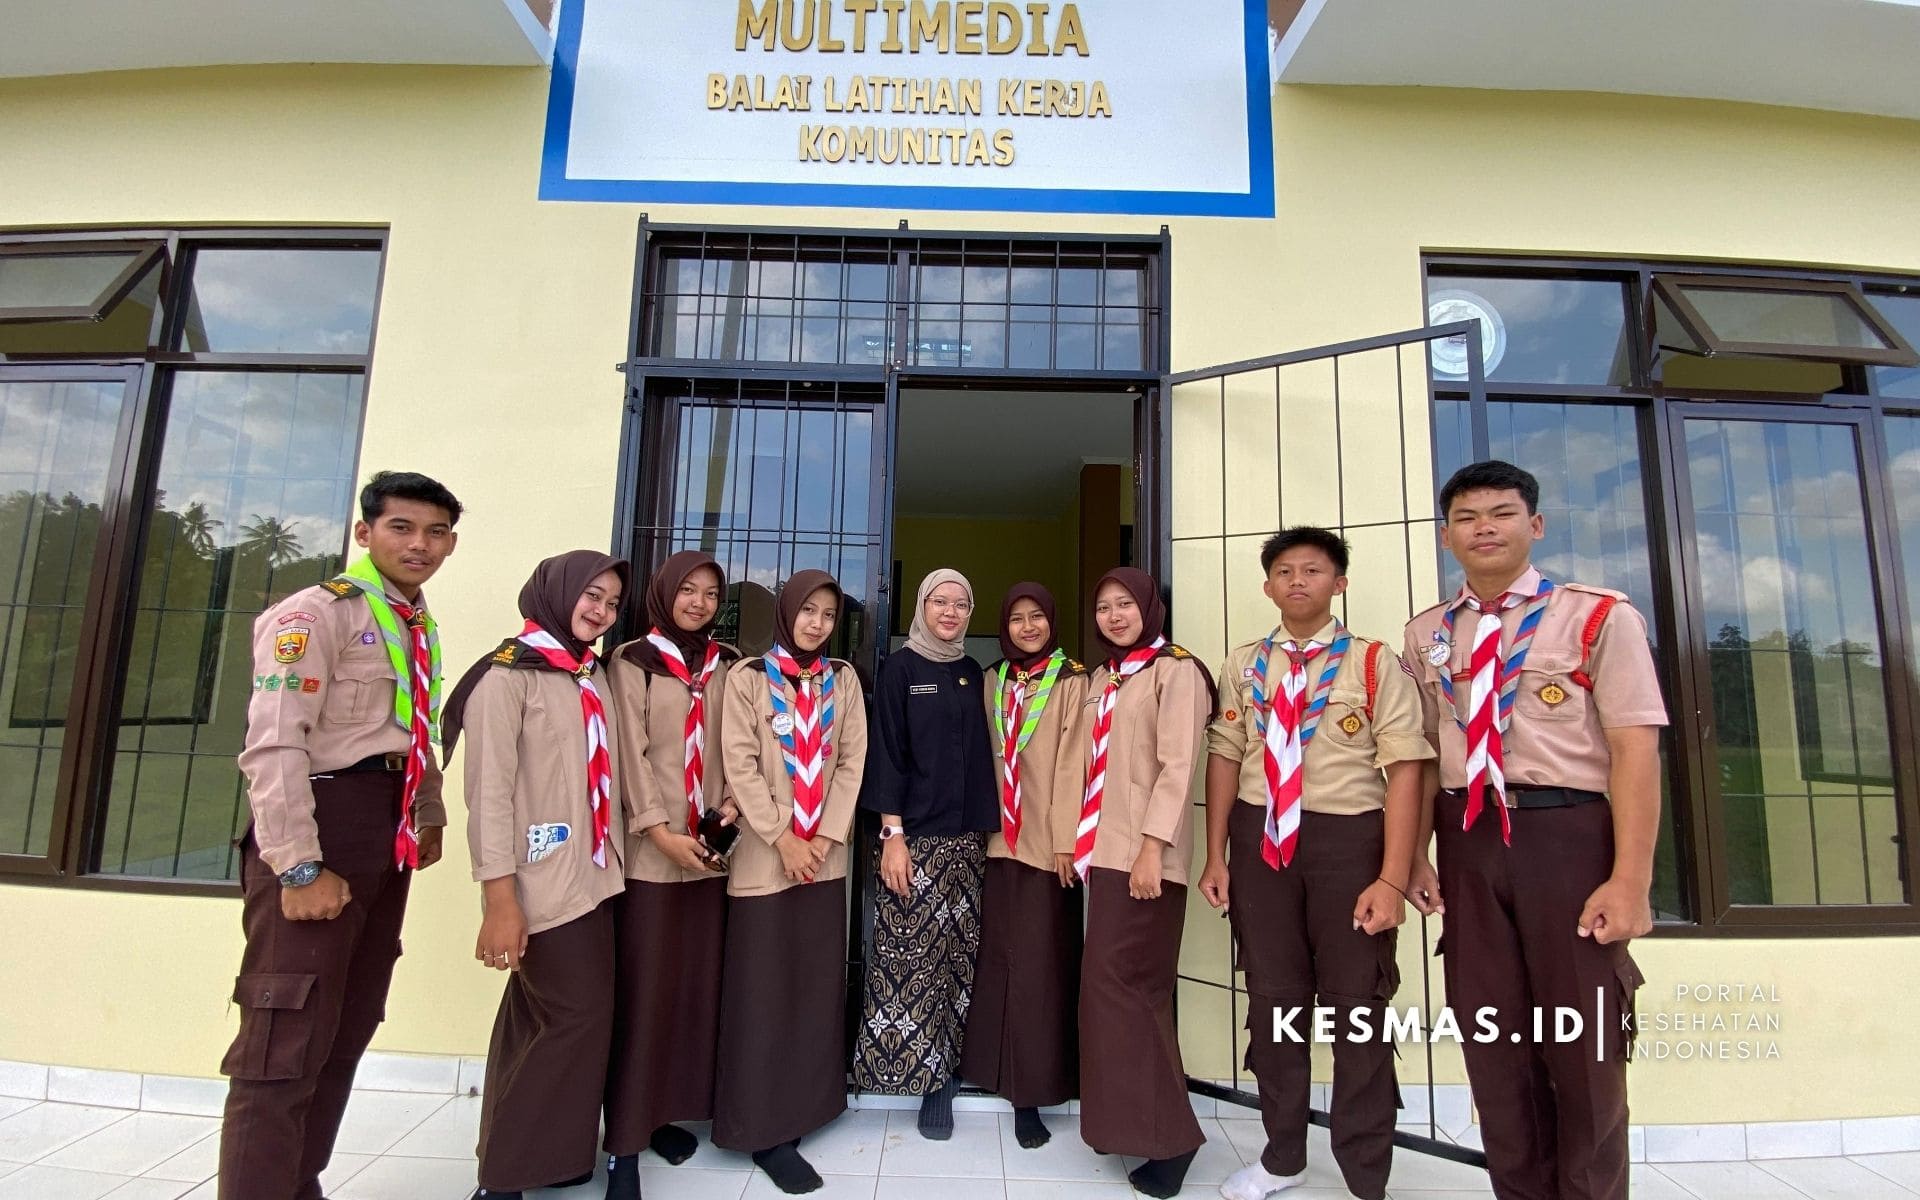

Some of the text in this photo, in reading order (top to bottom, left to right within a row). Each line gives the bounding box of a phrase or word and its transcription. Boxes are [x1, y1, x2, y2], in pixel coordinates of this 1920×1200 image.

[735, 0, 1090, 56] MULTIMEDIA
[707, 73, 1112, 118] BALAI LATIHAN KERJA
[799, 125, 1016, 167] KOMUNITAS
